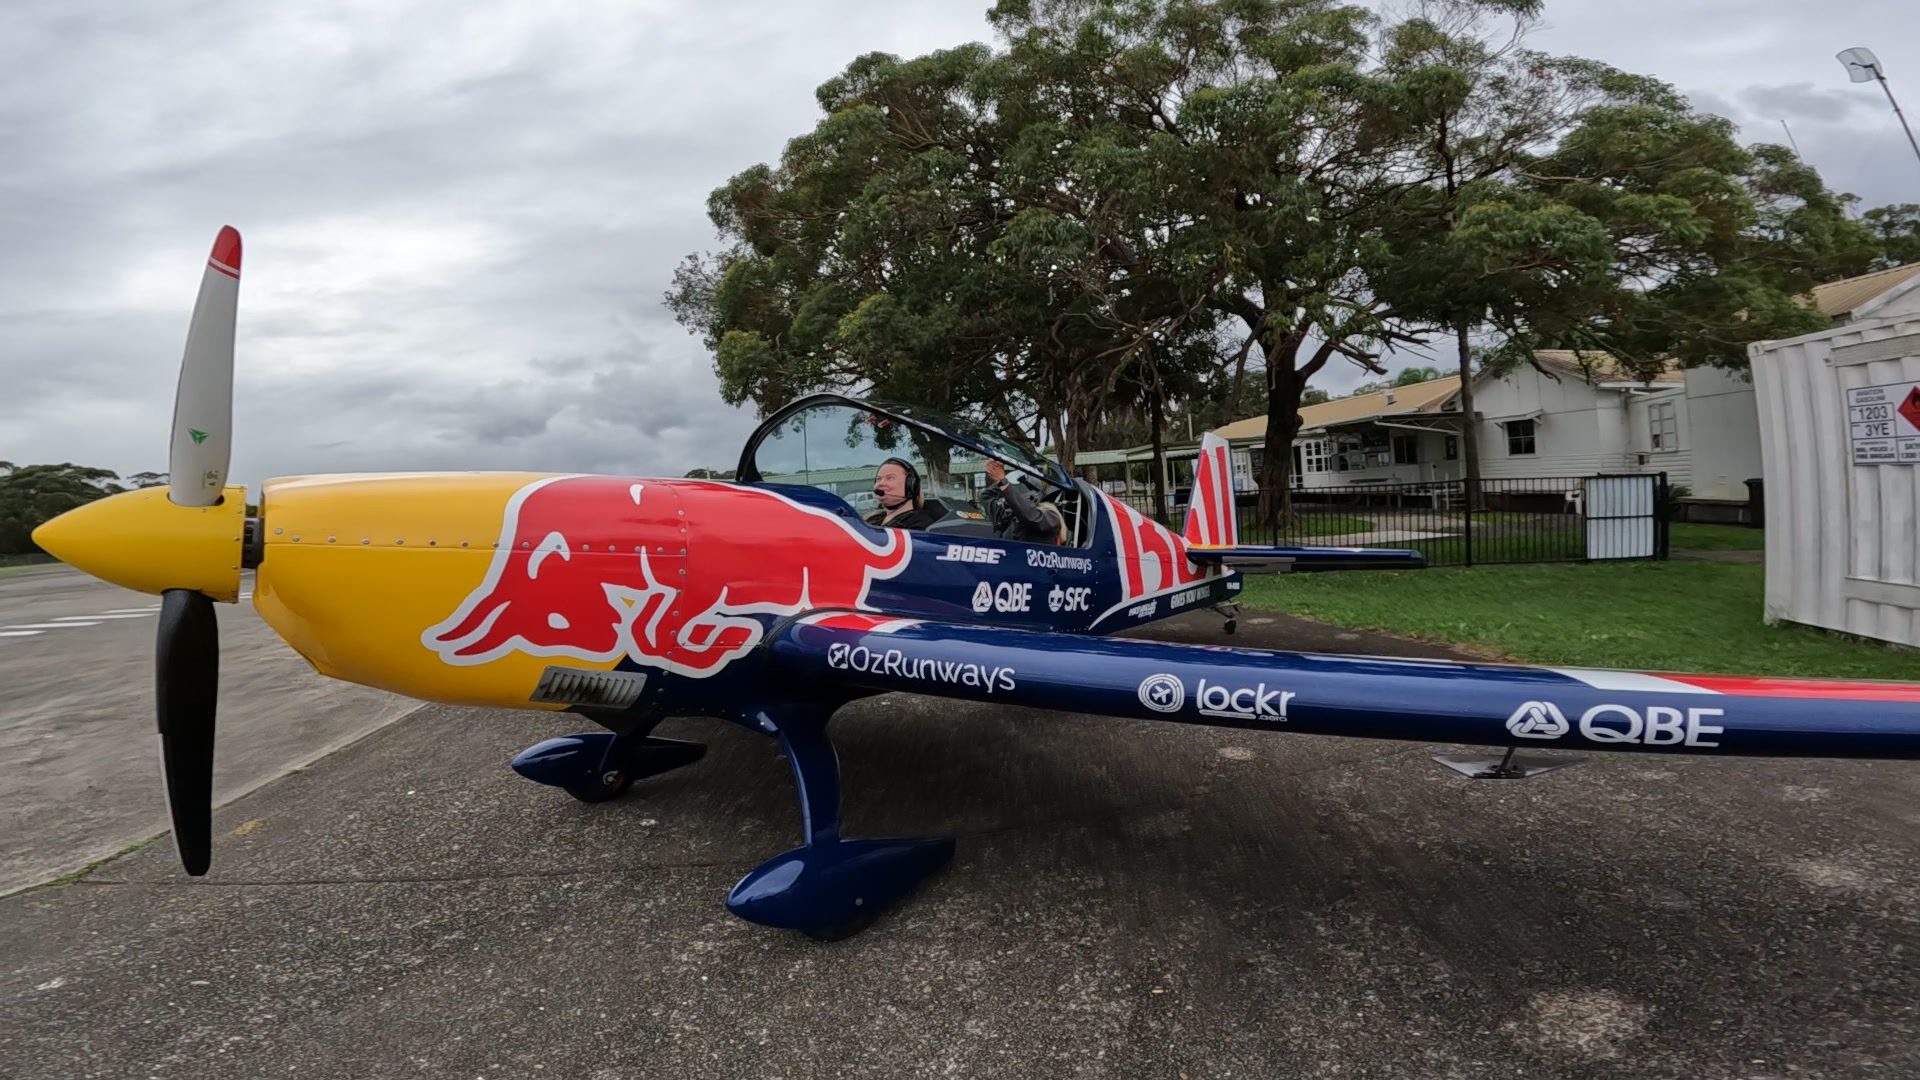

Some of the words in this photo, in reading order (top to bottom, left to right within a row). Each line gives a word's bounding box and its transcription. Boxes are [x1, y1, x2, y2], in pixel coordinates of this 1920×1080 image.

[1858, 406, 1889, 420] 1203
[1865, 422, 1890, 437] 3YE
[936, 544, 1007, 565] BOSE
[1037, 551, 1093, 573] OzRunways
[994, 581, 1033, 613] QBE
[1064, 586, 1092, 612] SFC
[850, 645, 1016, 694] OzRunways
[1196, 678, 1296, 717] lockr
[1579, 703, 1725, 748] QBE
